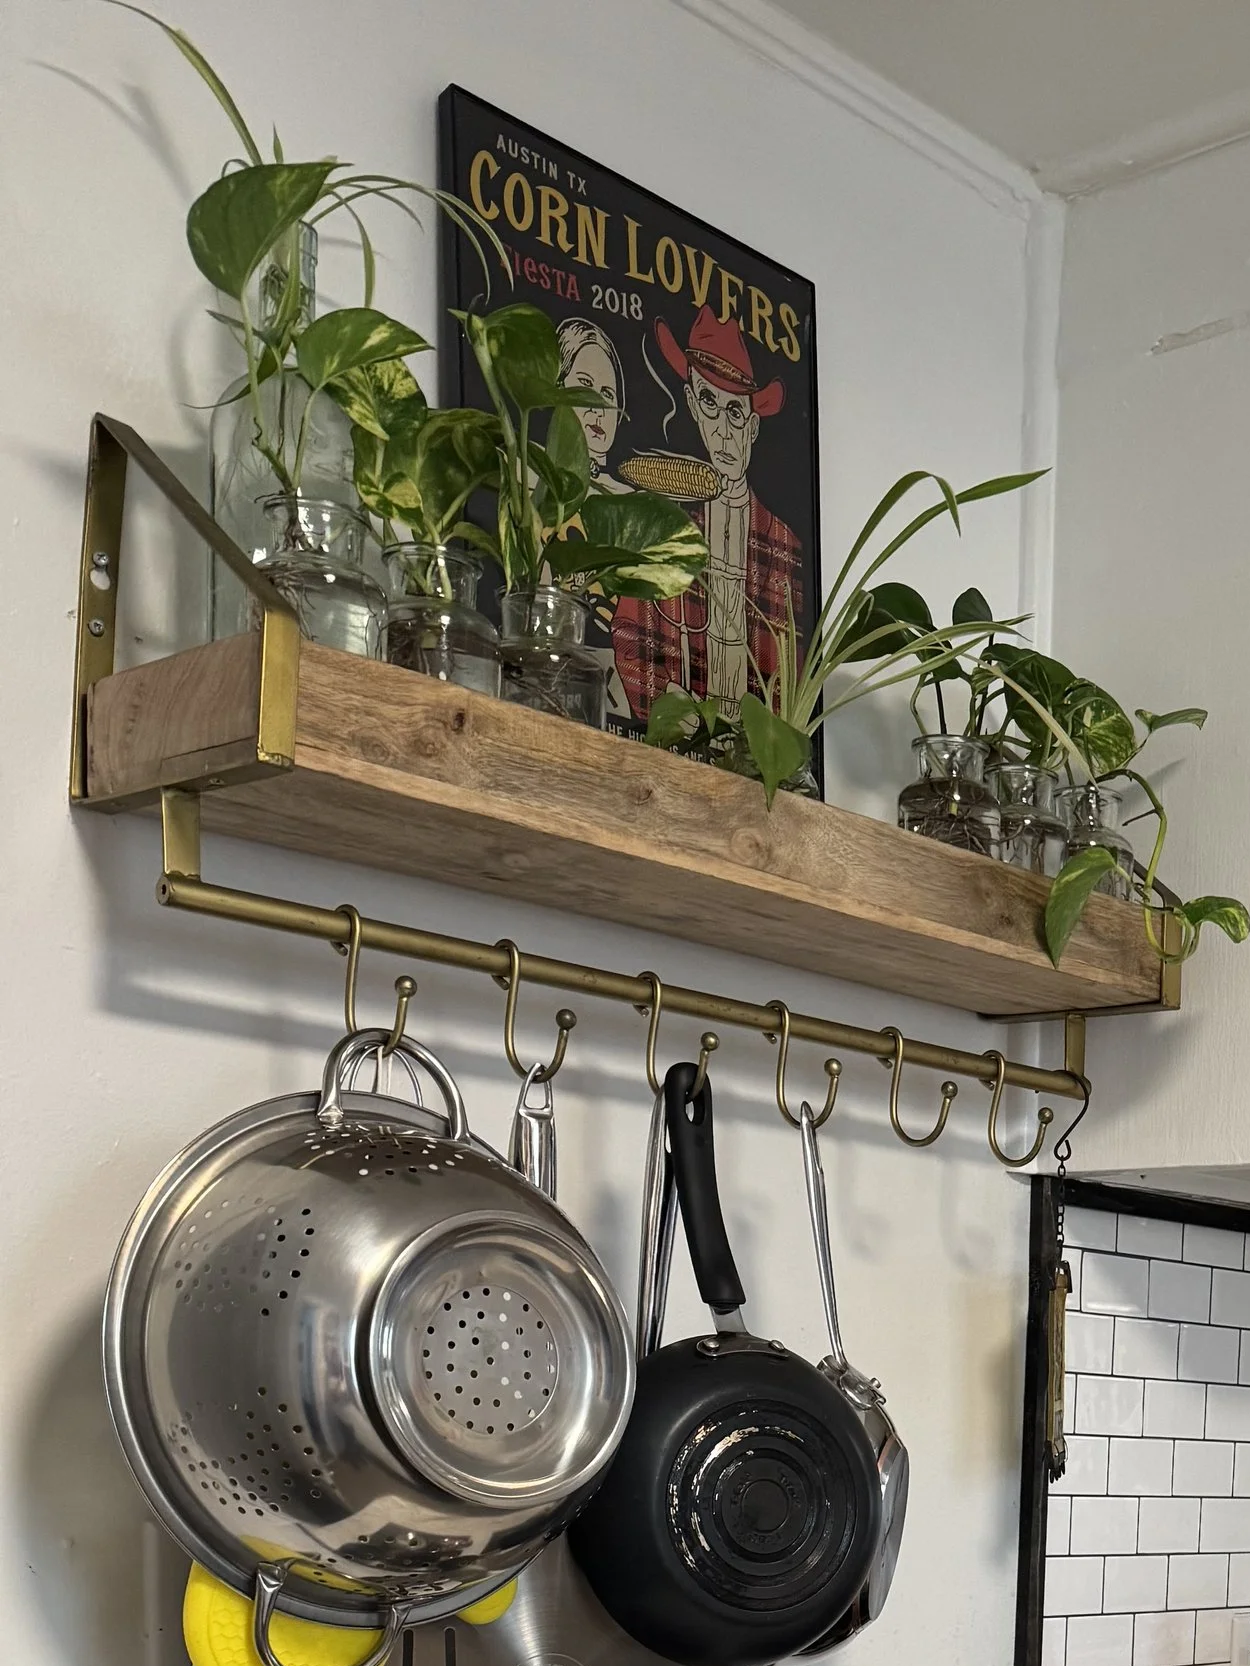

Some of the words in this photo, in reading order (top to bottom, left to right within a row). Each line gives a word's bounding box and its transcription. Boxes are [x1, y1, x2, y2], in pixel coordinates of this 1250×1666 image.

[496, 134, 559, 181] AUSTIN
[567, 170, 587, 196] TX
[470, 149, 611, 270] CORN
[623, 213, 801, 363] LOVERS
[591, 284, 643, 321] 2018
